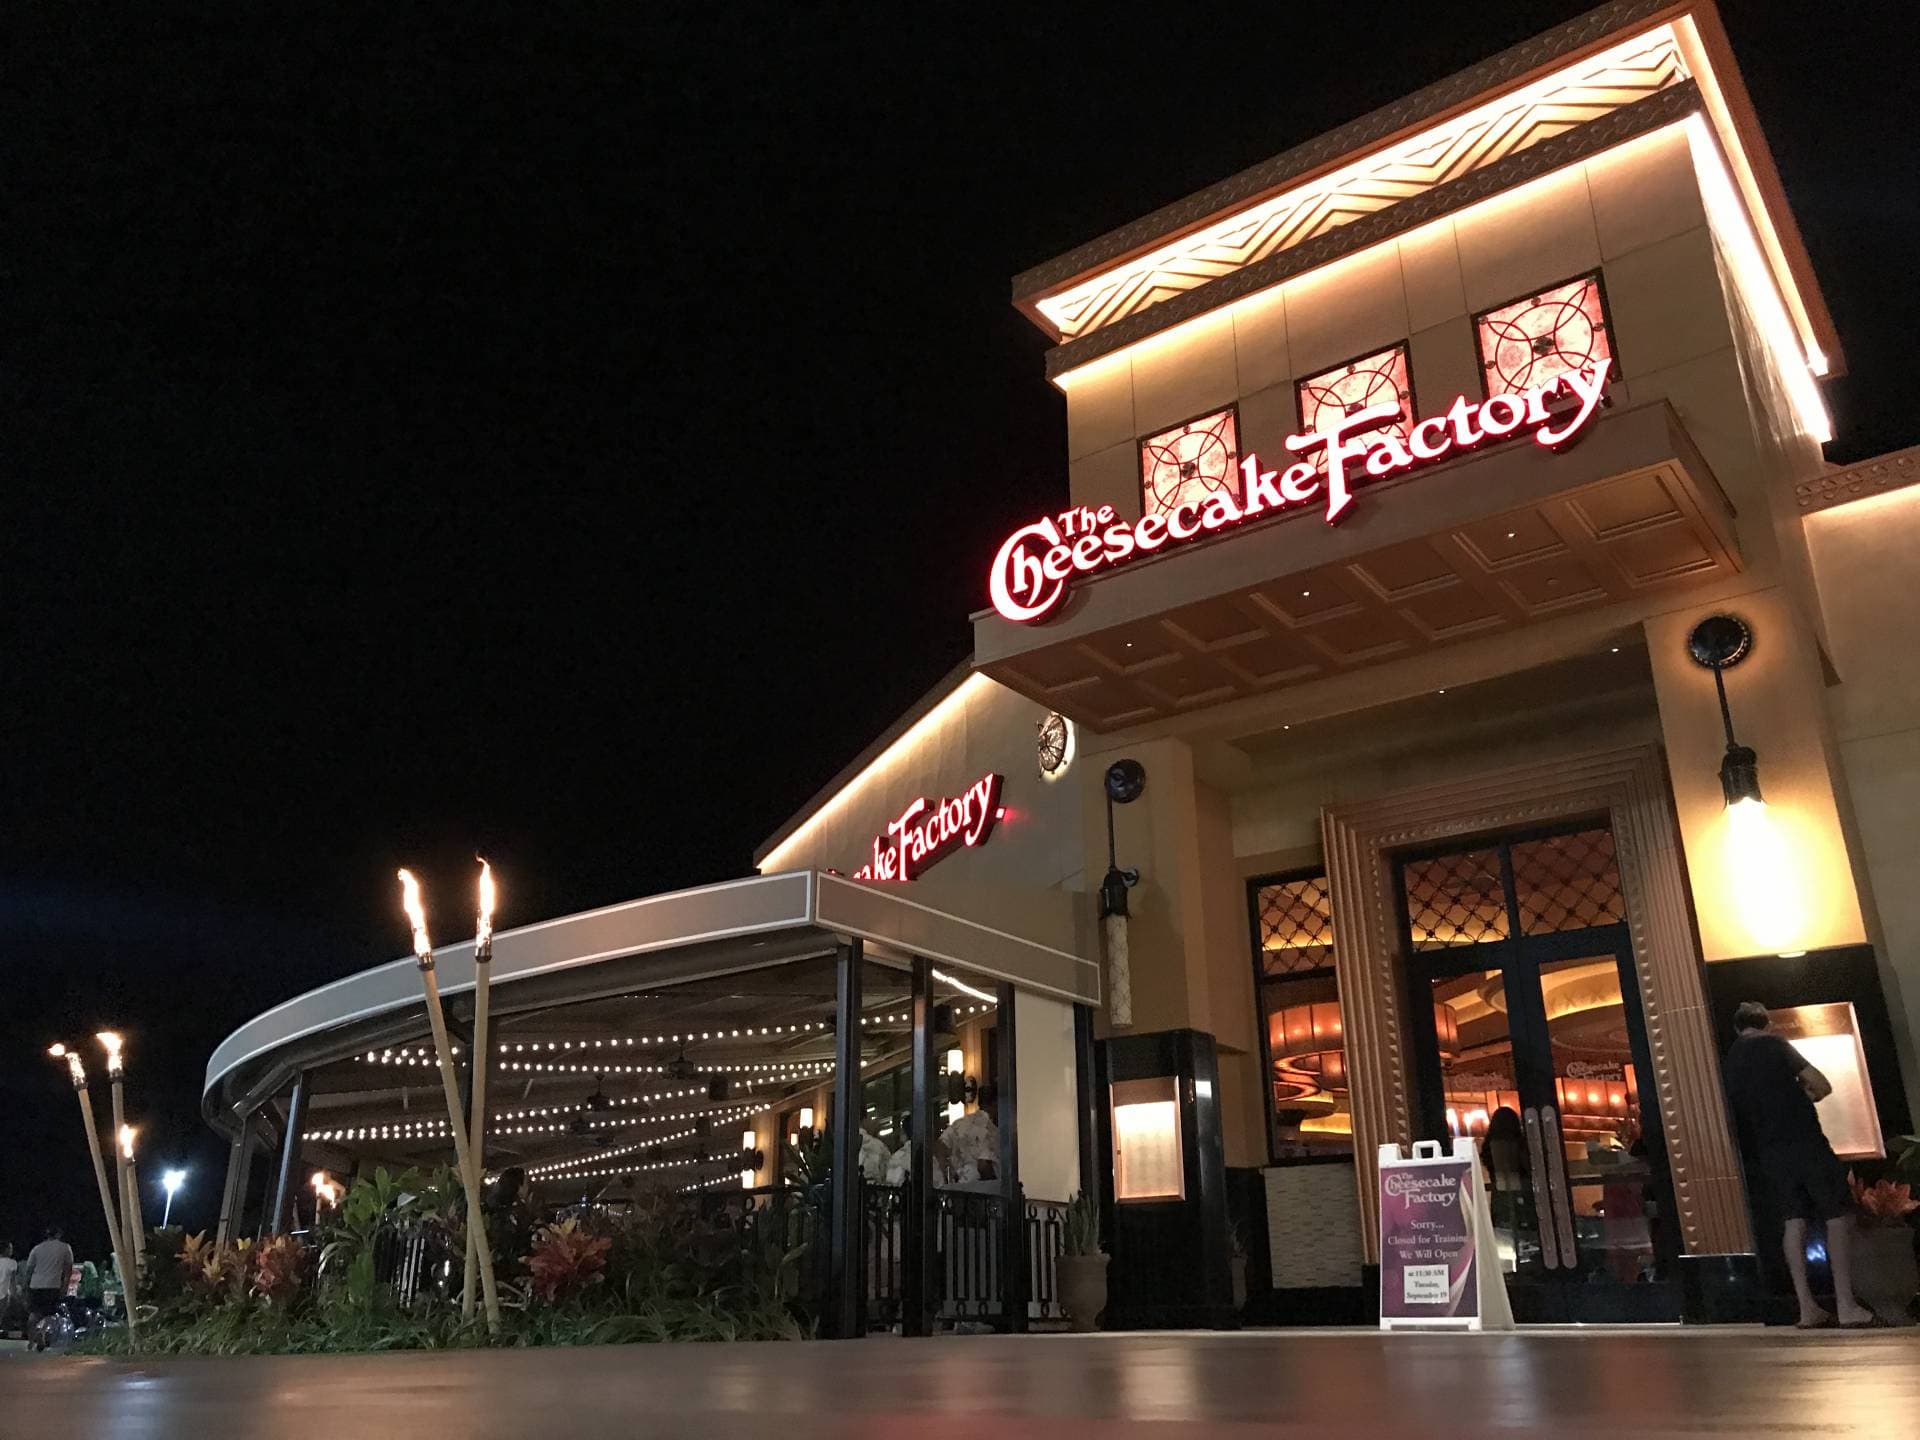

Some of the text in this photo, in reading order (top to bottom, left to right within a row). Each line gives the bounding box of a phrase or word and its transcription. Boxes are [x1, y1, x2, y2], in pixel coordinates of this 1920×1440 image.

[989, 358, 1613, 621] The Cheesecake Factory
[888, 773, 994, 881] Factory
[1384, 1173, 1456, 1196] Cheesecake
[1399, 1188, 1456, 1209] Factory
[1388, 1235, 1416, 1245] Closed
[1418, 1234, 1431, 1244] for
[1400, 1249, 1458, 1260] We Will Open
